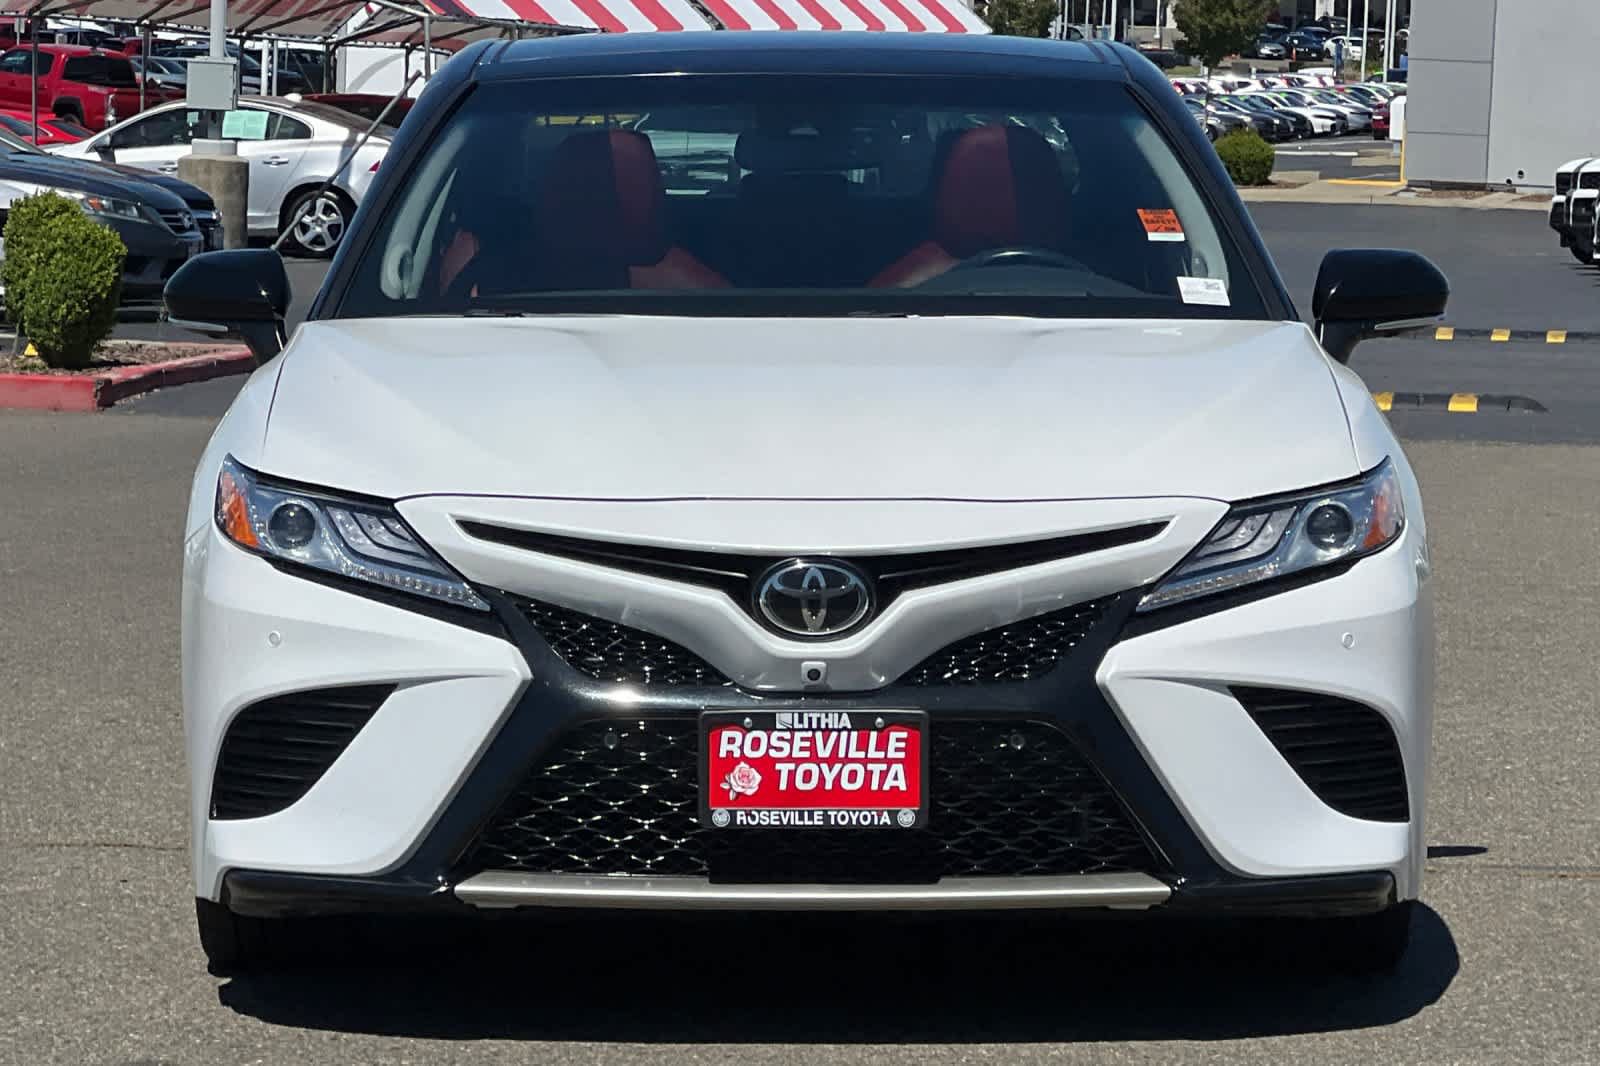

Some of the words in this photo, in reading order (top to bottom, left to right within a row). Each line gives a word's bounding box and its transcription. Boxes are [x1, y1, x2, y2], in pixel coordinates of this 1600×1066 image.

[793, 712, 852, 729] LITHIA
[719, 730, 908, 759] ROSEVILLE
[775, 762, 907, 791] TOYOTA
[736, 810, 824, 826] ROSEVILLE
[827, 810, 891, 826] TOYOTA
